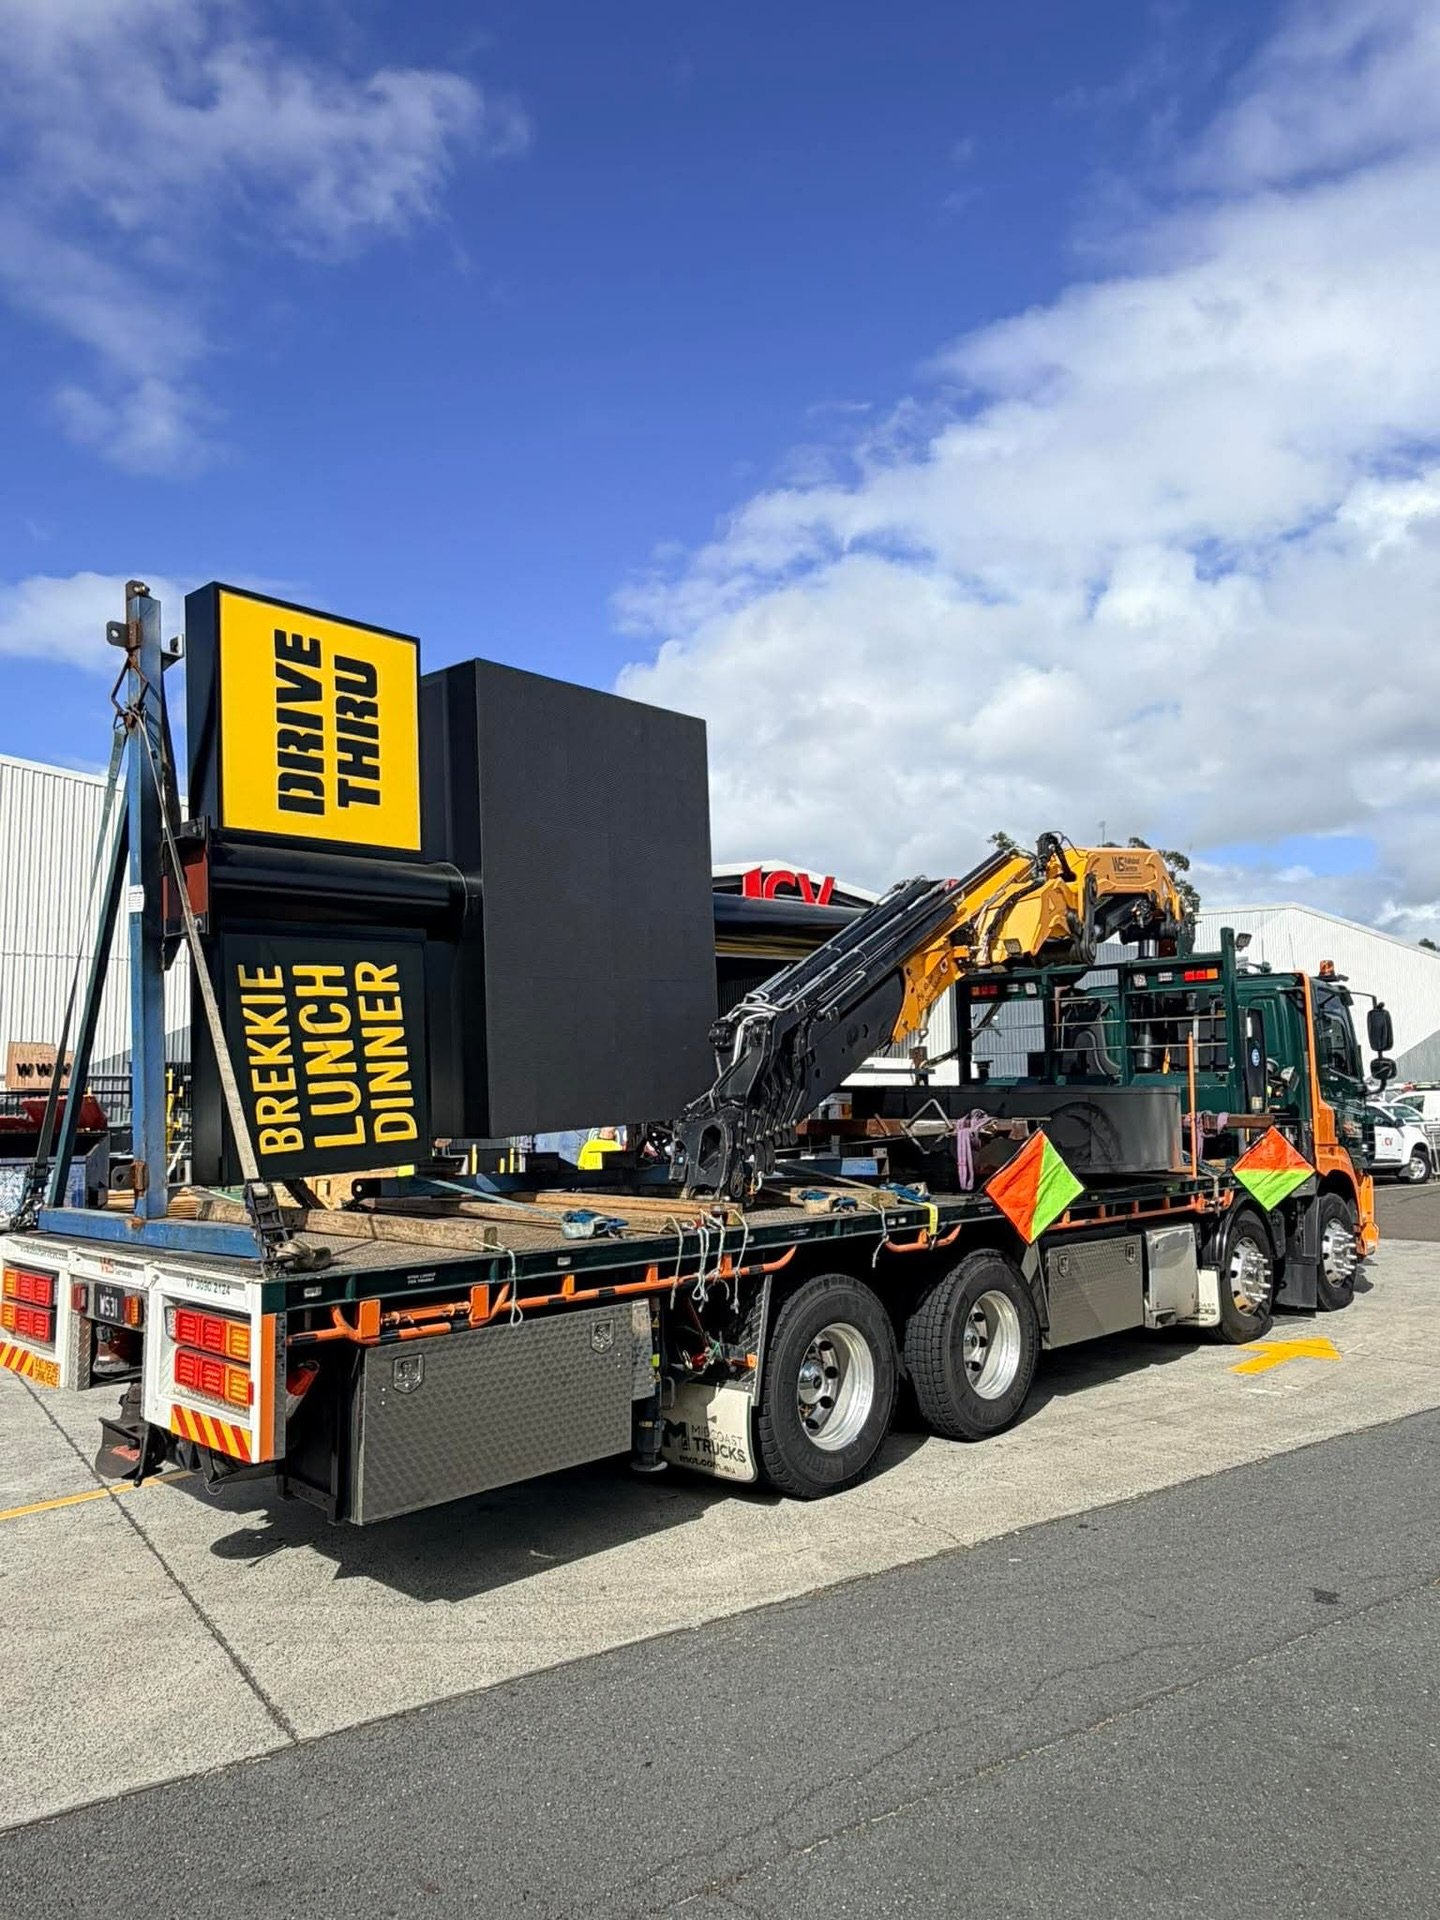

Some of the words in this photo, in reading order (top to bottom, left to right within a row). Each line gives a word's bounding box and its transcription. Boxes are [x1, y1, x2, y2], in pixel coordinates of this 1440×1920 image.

[274, 629, 325, 815] DRIVE
[334, 654, 380, 808] THRU
[237, 964, 304, 1154] BREKKIE
[292, 965, 366, 1148] LUNCH
[354, 961, 418, 1143] DINNER
[692, 1437, 746, 1464] TRUCKS
